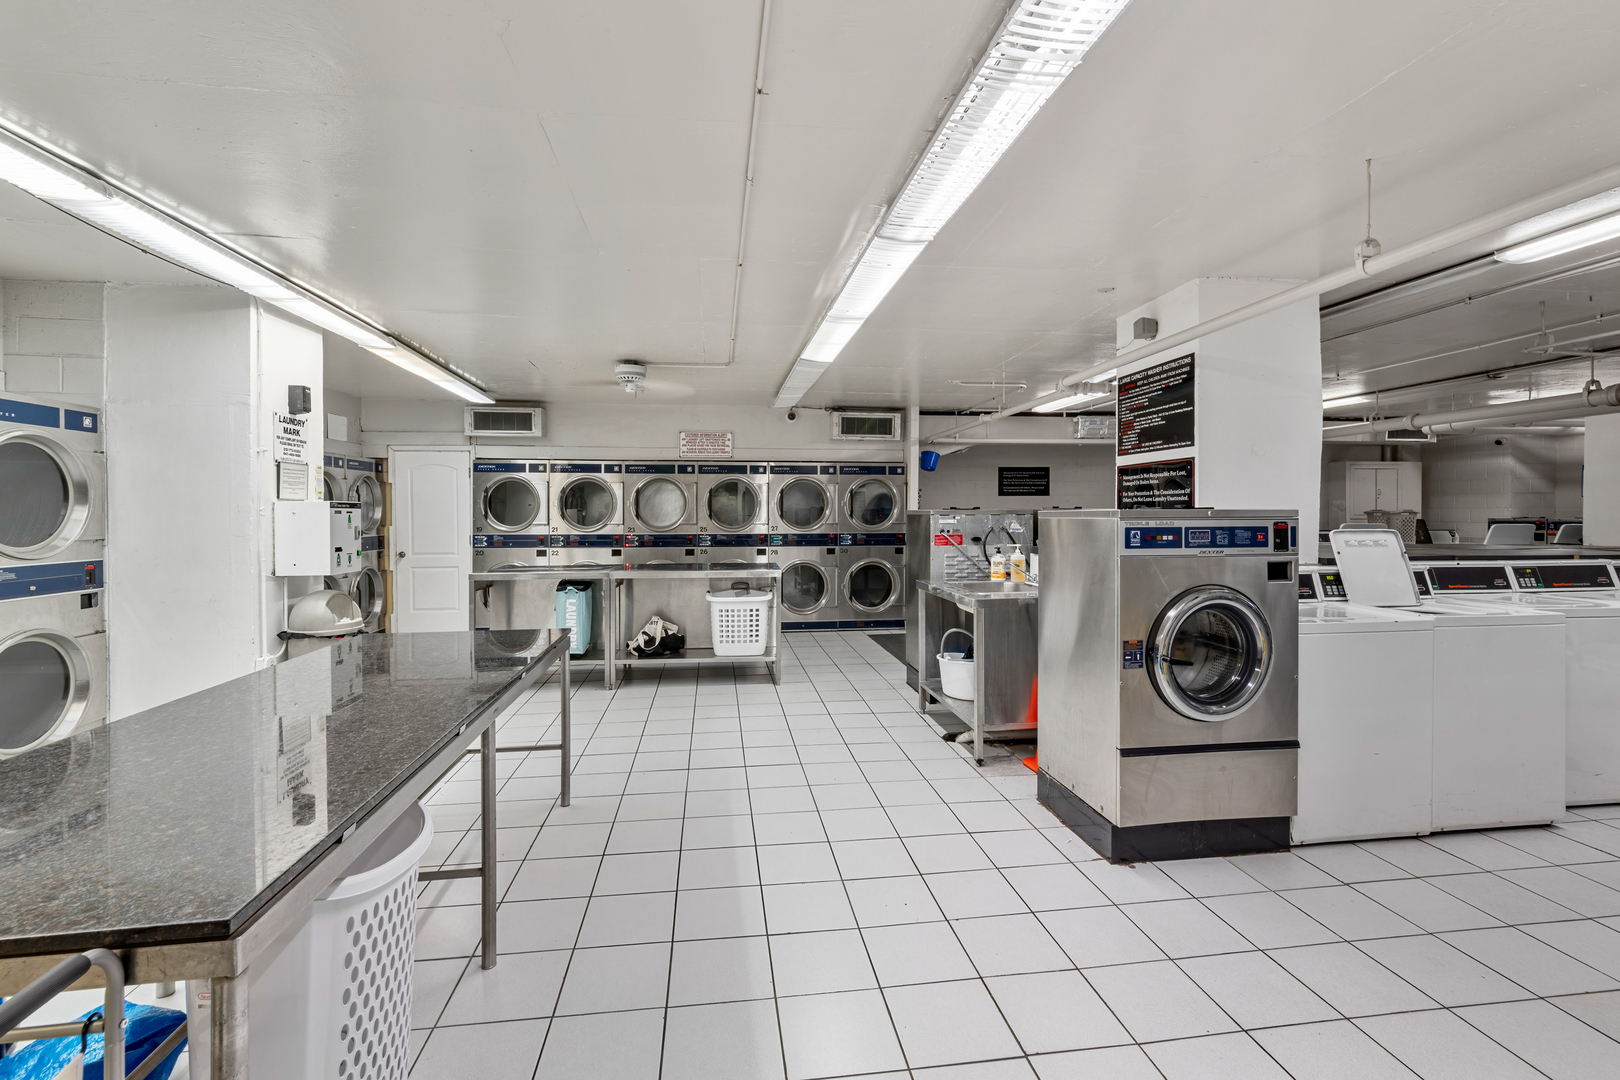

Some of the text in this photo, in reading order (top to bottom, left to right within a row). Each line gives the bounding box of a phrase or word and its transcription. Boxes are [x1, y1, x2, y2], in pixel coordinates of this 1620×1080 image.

[1131, 372, 1147, 381] CAPACITY
[1148, 367, 1162, 375] WASHER
[1163, 357, 1191, 371] INSTRUCTIONS
[279, 415, 305, 428] LAUNDRY
[283, 427, 300, 437] MARK
[566, 599, 577, 648] LAUNDRY
